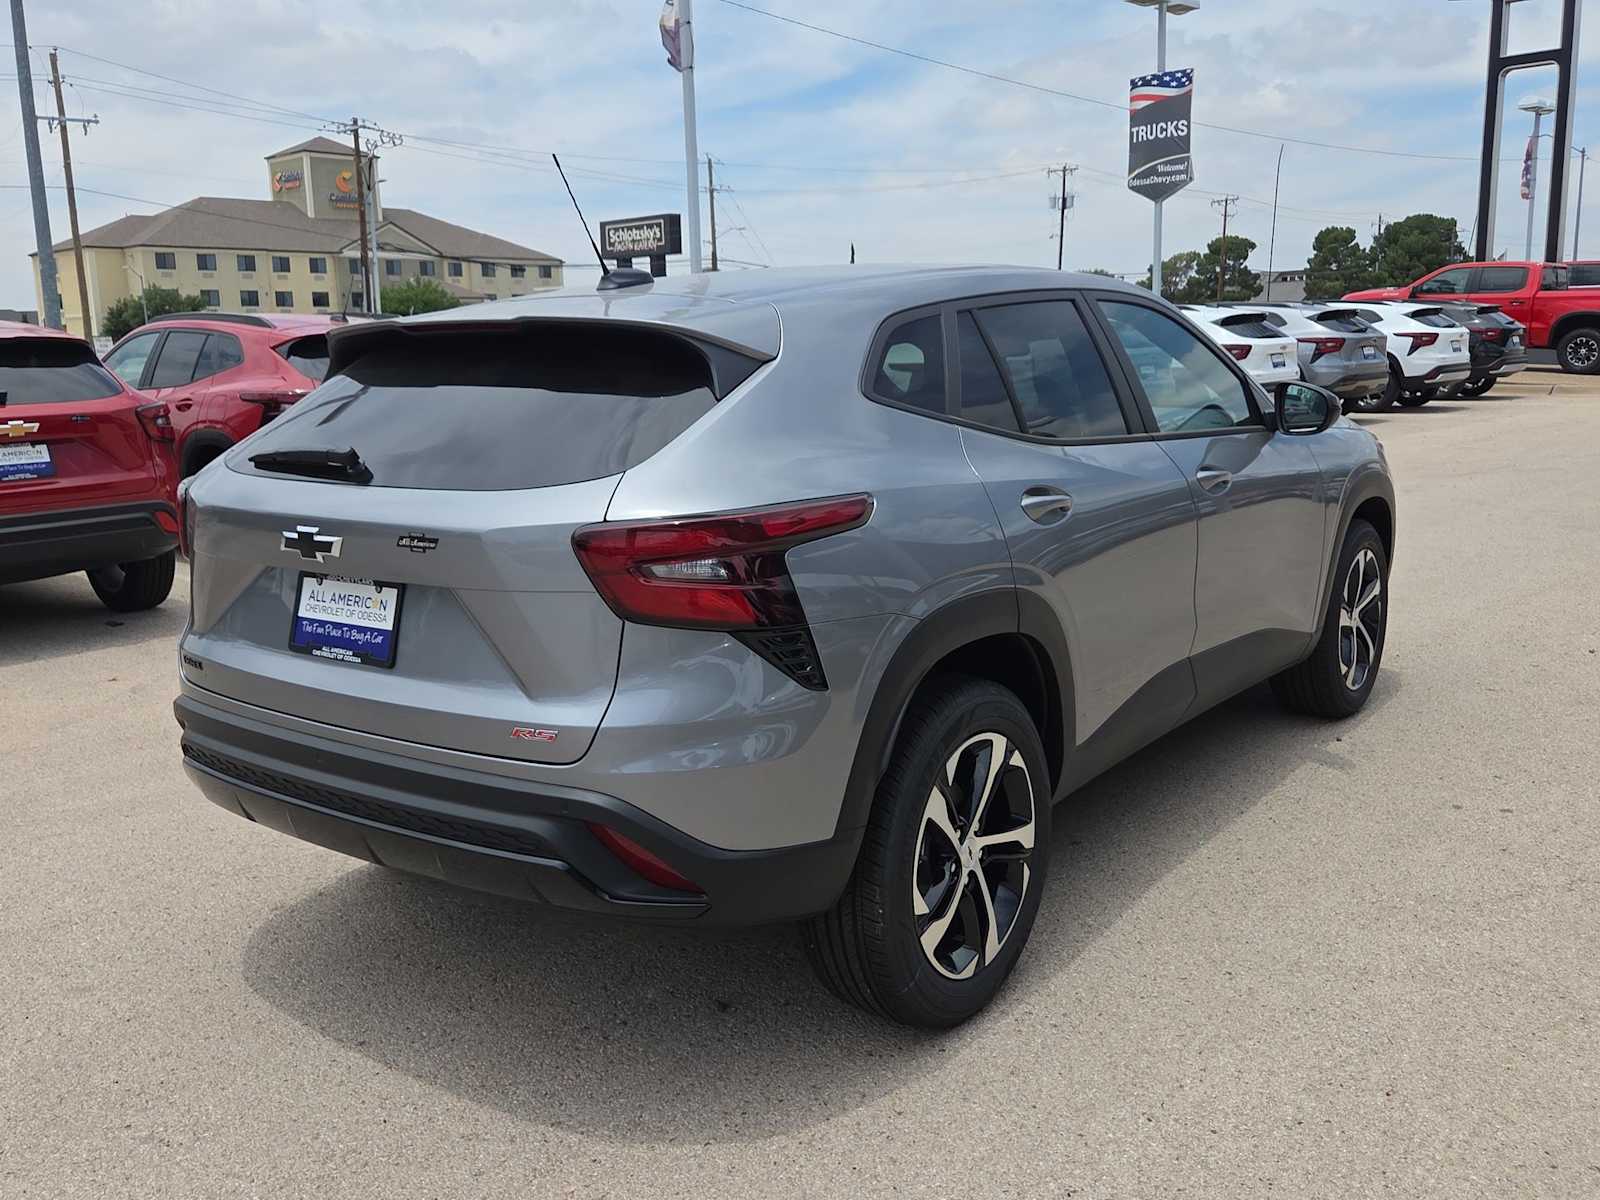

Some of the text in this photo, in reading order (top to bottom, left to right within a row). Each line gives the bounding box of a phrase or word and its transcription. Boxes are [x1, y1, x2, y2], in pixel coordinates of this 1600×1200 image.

[1131, 119, 1188, 143] TRUCKS
[609, 224, 661, 243] Schlotzsky's
[308, 589, 326, 603] ALL
[304, 603, 387, 623] CHEVROLET OF ODESSA
[302, 620, 313, 632] The
[325, 624, 342, 637] Place
[342, 627, 351, 638] To
[350, 629, 364, 645] Buy
[364, 631, 371, 643] A
[371, 632, 384, 644] Car
[511, 726, 559, 743] RS
